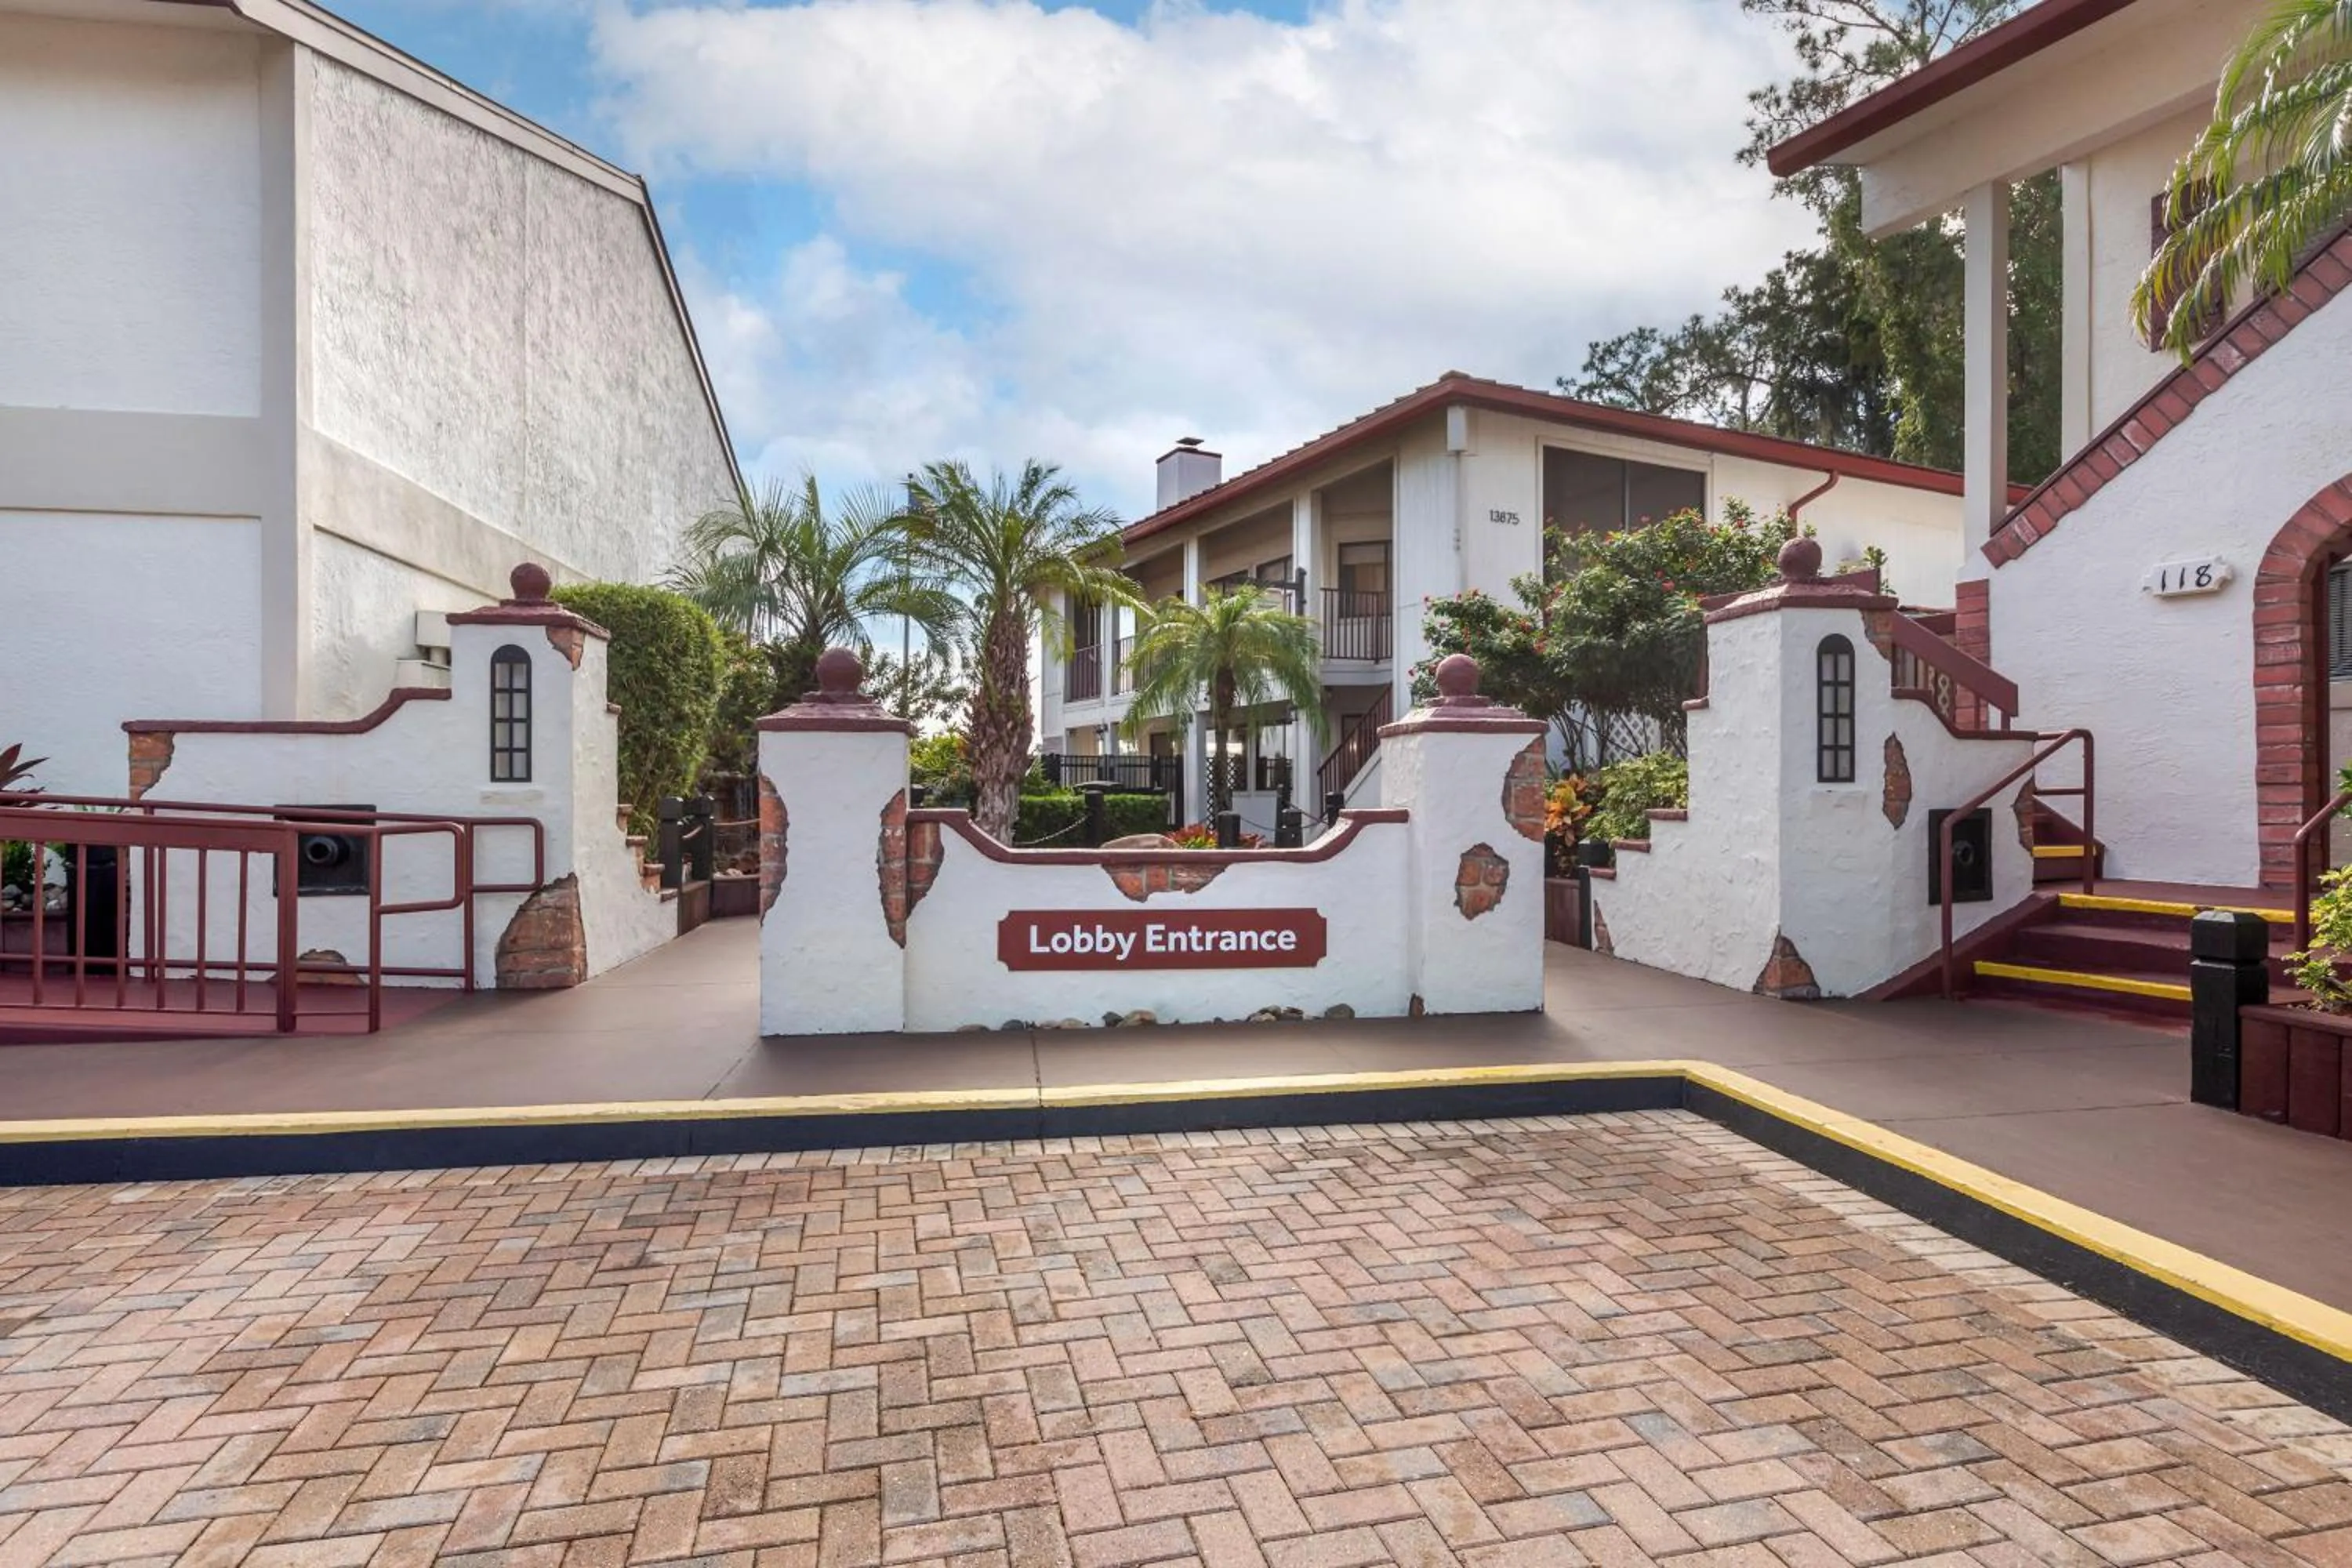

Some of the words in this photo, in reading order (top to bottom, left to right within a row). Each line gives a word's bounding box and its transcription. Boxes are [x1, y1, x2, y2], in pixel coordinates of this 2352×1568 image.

[2161, 564, 2212, 591] 118
[1029, 924, 1137, 960] Lobby
[1145, 924, 1297, 953] Entrance
